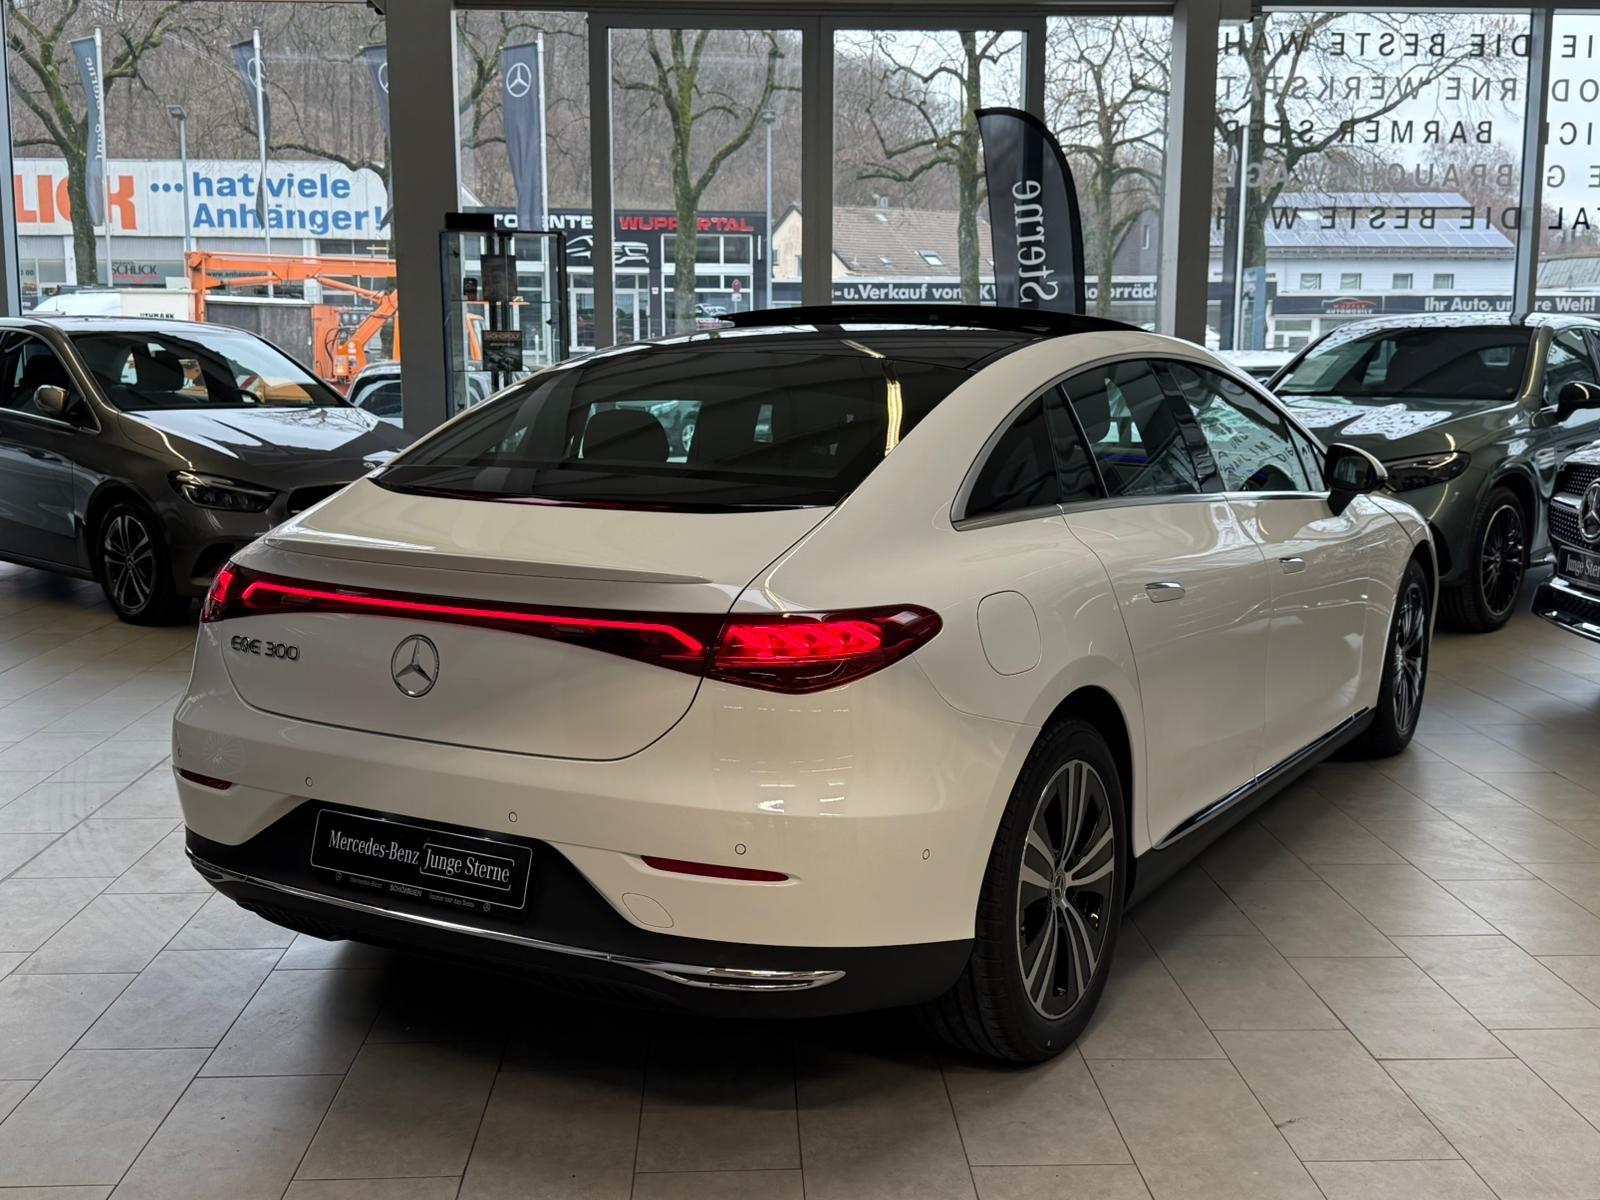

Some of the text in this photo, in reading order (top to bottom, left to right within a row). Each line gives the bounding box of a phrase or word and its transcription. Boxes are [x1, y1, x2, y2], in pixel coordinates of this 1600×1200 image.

[193, 172, 254, 197] hat
[266, 173, 350, 199] viele
[619, 216, 753, 231] WUPPRTAL
[1424, 297, 1596, 312] Ihr Auto, unre Welt!
[231, 635, 299, 660] EQE 300
[328, 829, 510, 883] Mercedes-Benz Junge Sterne
